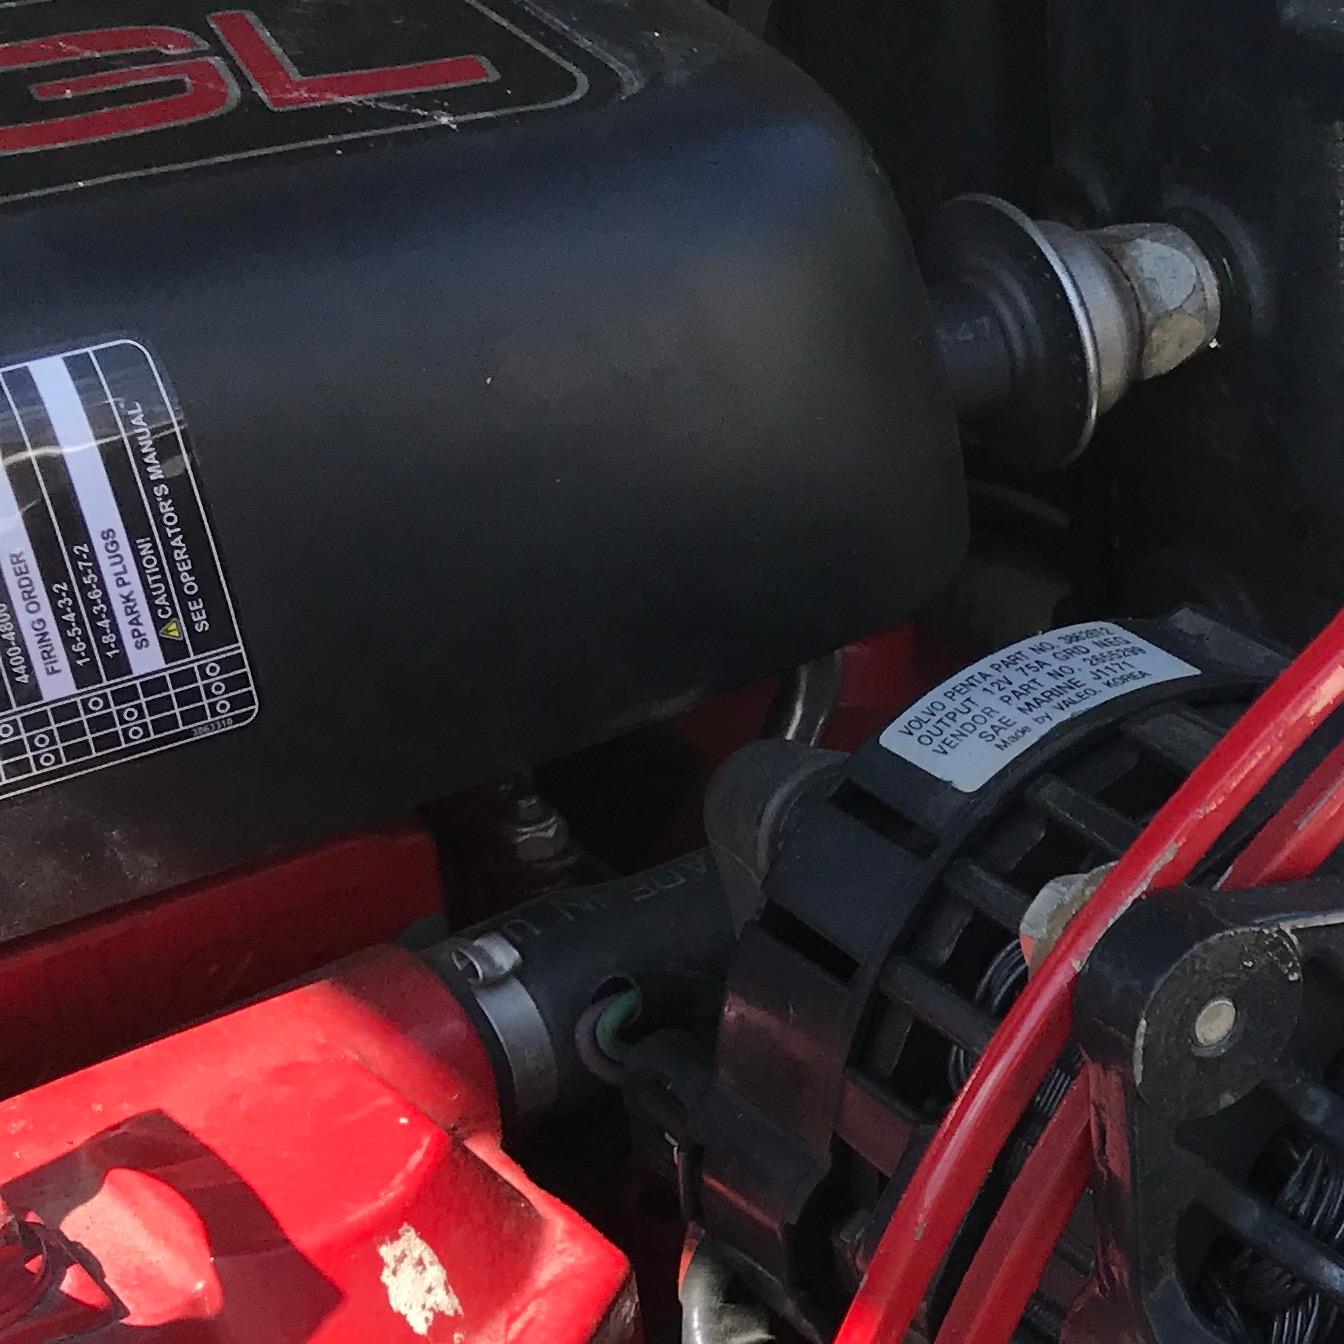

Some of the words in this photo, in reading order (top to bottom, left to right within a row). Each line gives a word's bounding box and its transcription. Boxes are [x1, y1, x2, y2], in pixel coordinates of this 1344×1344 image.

[127, 400, 166, 481] MANUAL
[101, 527, 132, 588] PLUGS
[135, 537, 173, 620] CAUTION!
[154, 482, 199, 596] OPERATOR'S
[9, 551, 41, 615] ORDER
[72, 543, 120, 660] 1-8-4-3-6-5-7-2
[123, 589, 150, 651] SPARK
[188, 598, 210, 633] SEE
[31, 617, 62, 676] FIRING
[51, 581, 91, 667] 1-6-5-4-3-2
[898, 700, 946, 737] VOLVO
[943, 671, 993, 701] PENTA
[989, 651, 1029, 673] PART
[917, 697, 979, 746] OUTPUT
[982, 675, 1013, 696] 12V
[1014, 659, 1051, 677] 75A
[1052, 644, 1091, 662] GRD
[1092, 636, 1131, 650] NEG
[931, 706, 1000, 756] VENDOR
[999, 678, 1045, 706] PART
[978, 715, 1018, 743] SAE
[1016, 677, 1087, 716] MARINE
[1089, 660, 1136, 681] J1171
[994, 727, 1032, 751] Made
[1032, 712, 1054, 726] by
